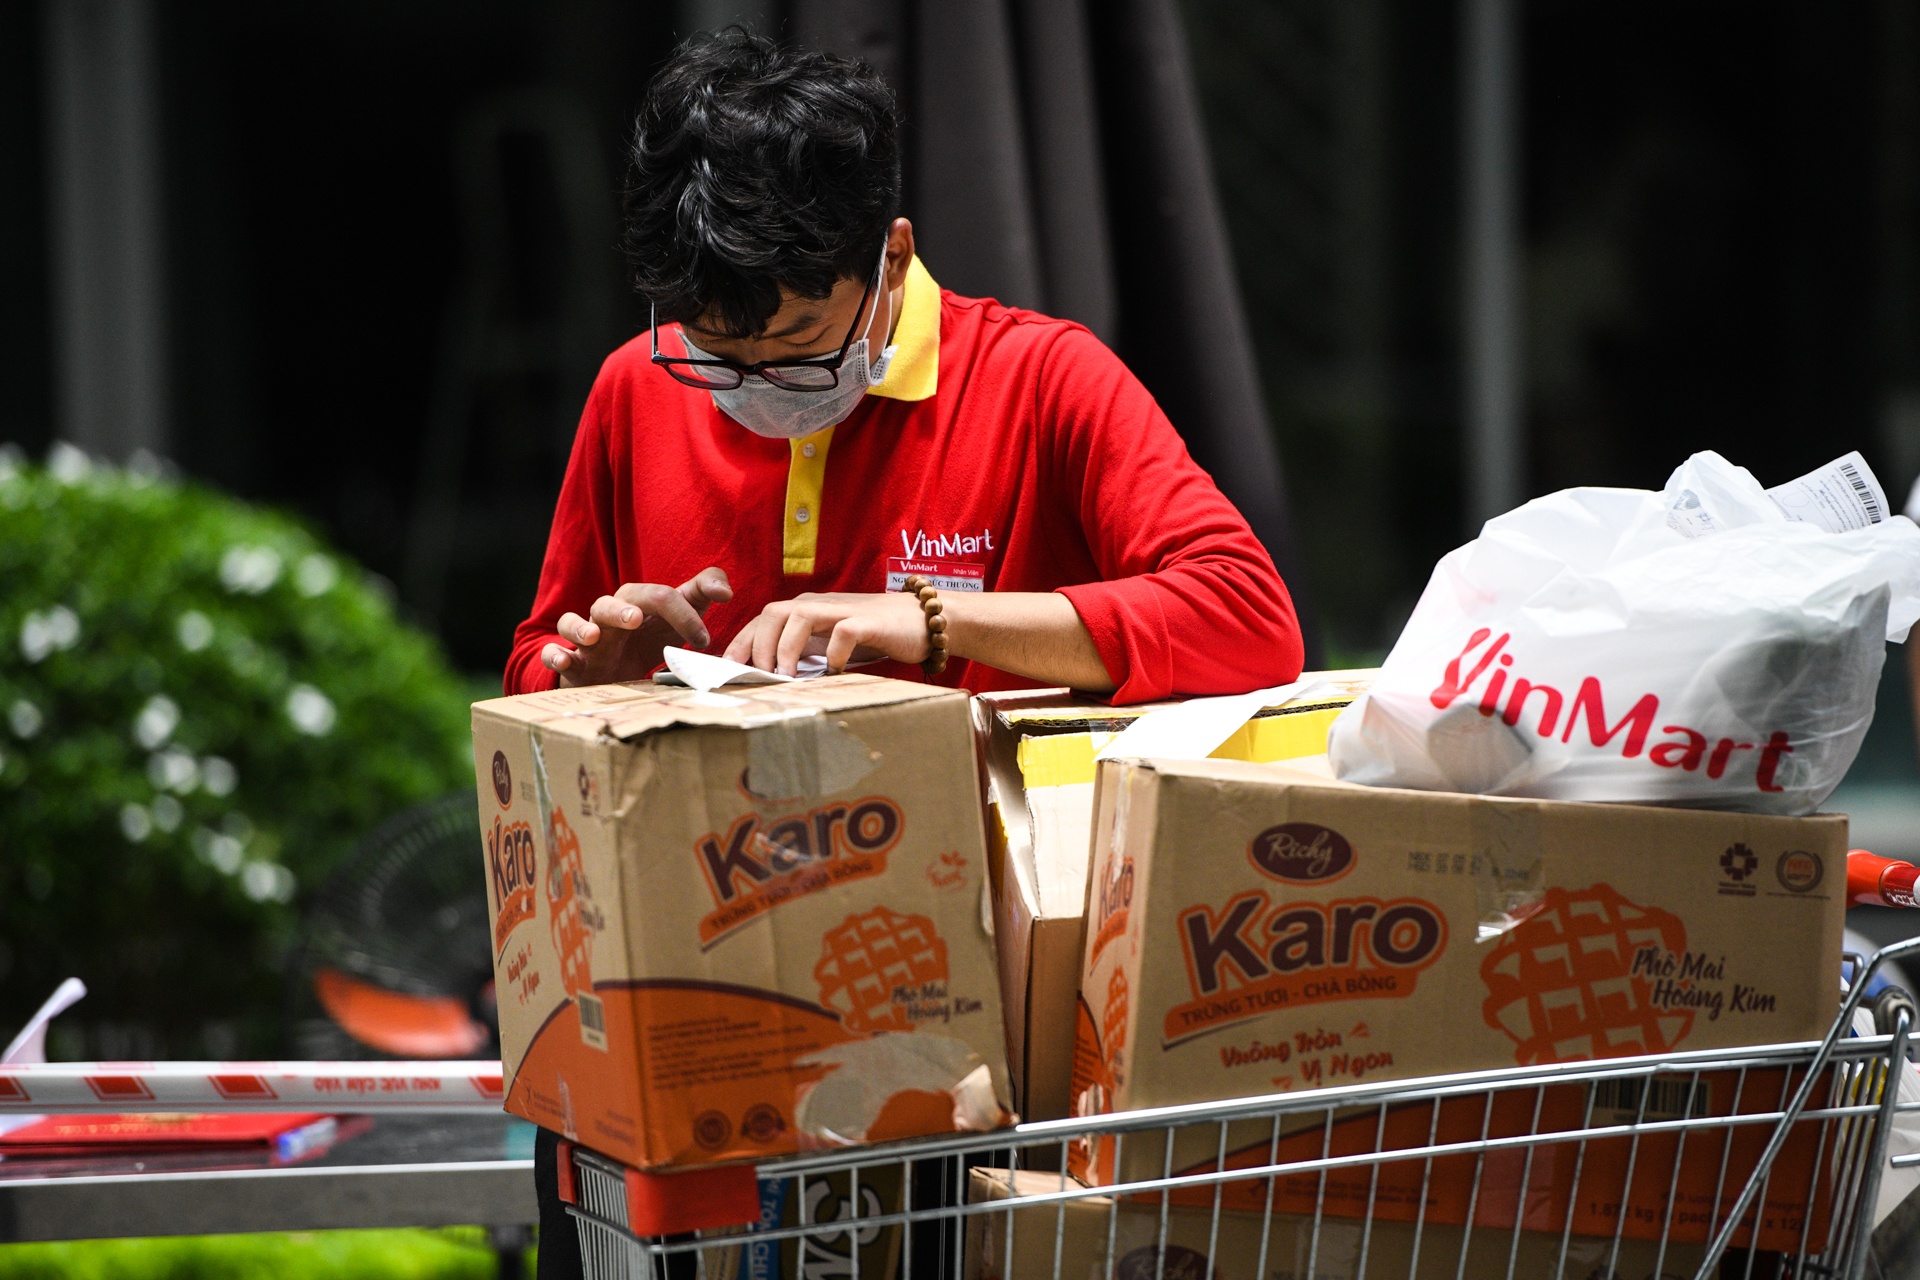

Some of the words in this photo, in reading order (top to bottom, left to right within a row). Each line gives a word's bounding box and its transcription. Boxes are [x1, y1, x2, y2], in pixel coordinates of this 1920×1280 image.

[900, 560, 938, 572] VinMart
[901, 528, 994, 560] VinMart
[1429, 628, 1794, 792] VinMart
[488, 822, 536, 912] Karo
[702, 802, 898, 900] Karo
[1265, 831, 1334, 877] Richy
[1186, 896, 1440, 994] Karo
[1679, 951, 1726, 981] Mai
[1304, 976, 1341, 999] CHÀ
[1346, 973, 1397, 993] BÔNG
[1652, 978, 1724, 1022] Hoàng
[1729, 983, 1777, 1014] Kim
[1329, 1052, 1394, 1078] Ngon
